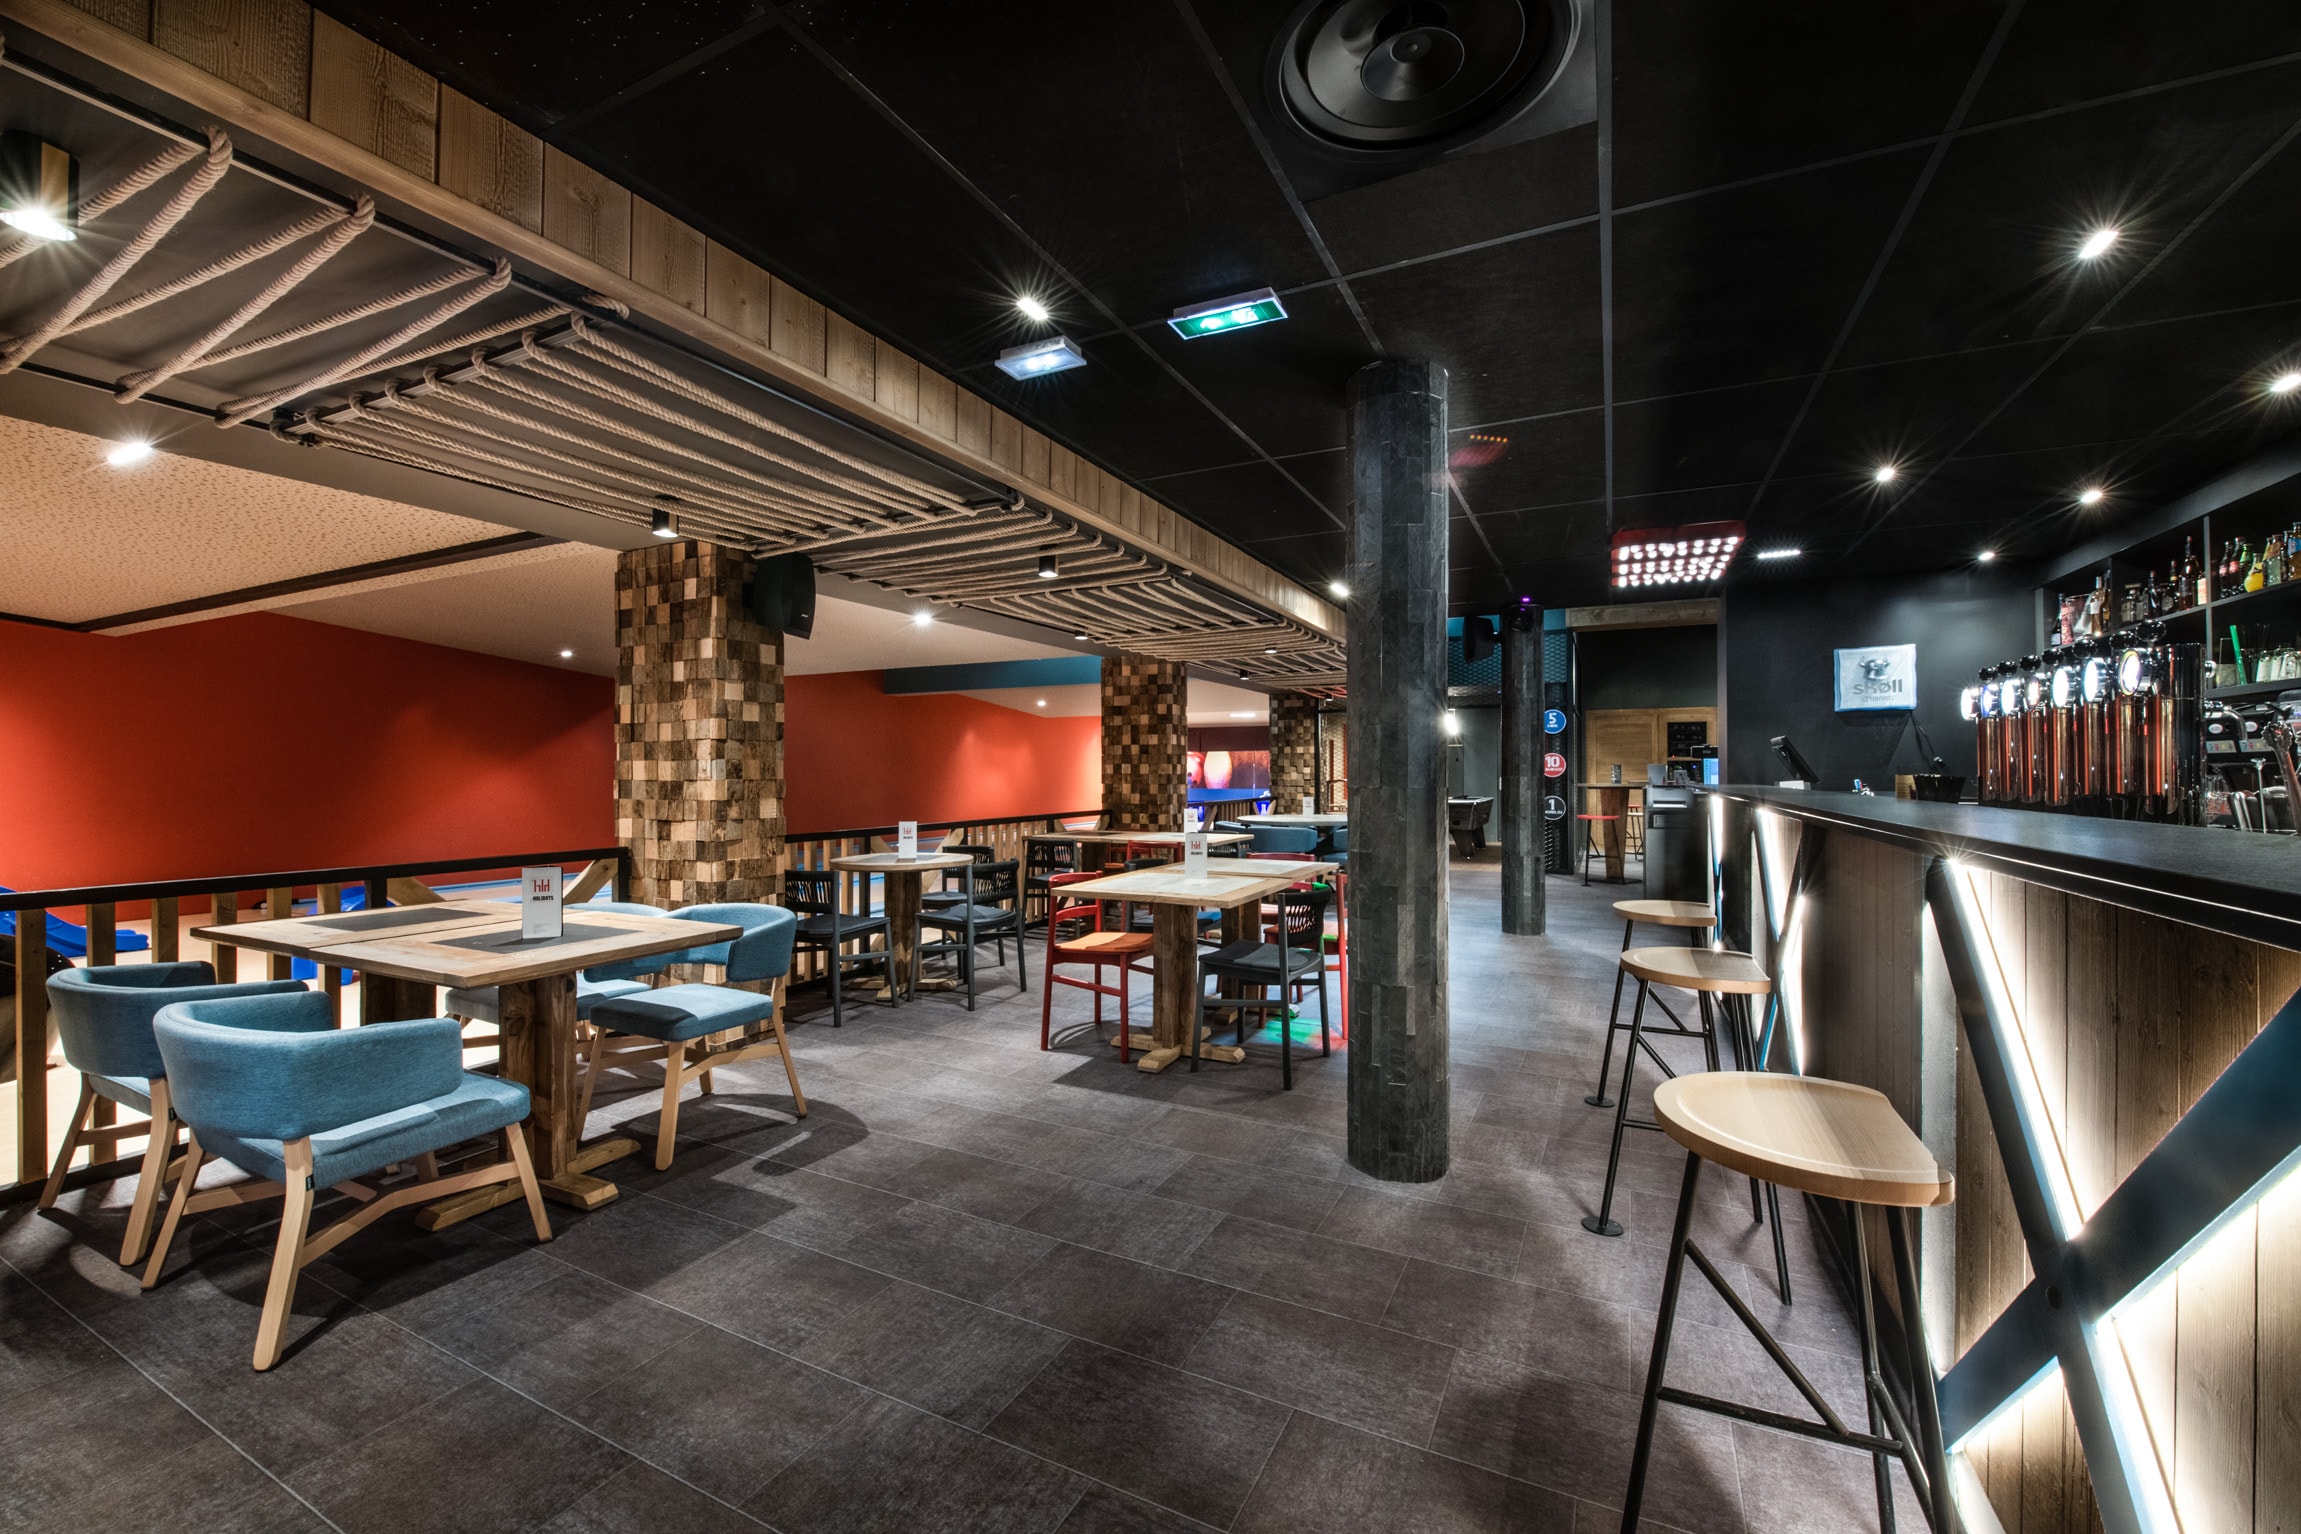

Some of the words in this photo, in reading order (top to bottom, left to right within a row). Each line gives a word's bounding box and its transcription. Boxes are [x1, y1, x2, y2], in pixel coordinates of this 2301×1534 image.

[1548, 712, 1557, 724] 5
[1545, 756, 1560, 767] 10
[1548, 799, 1555, 810] 1
